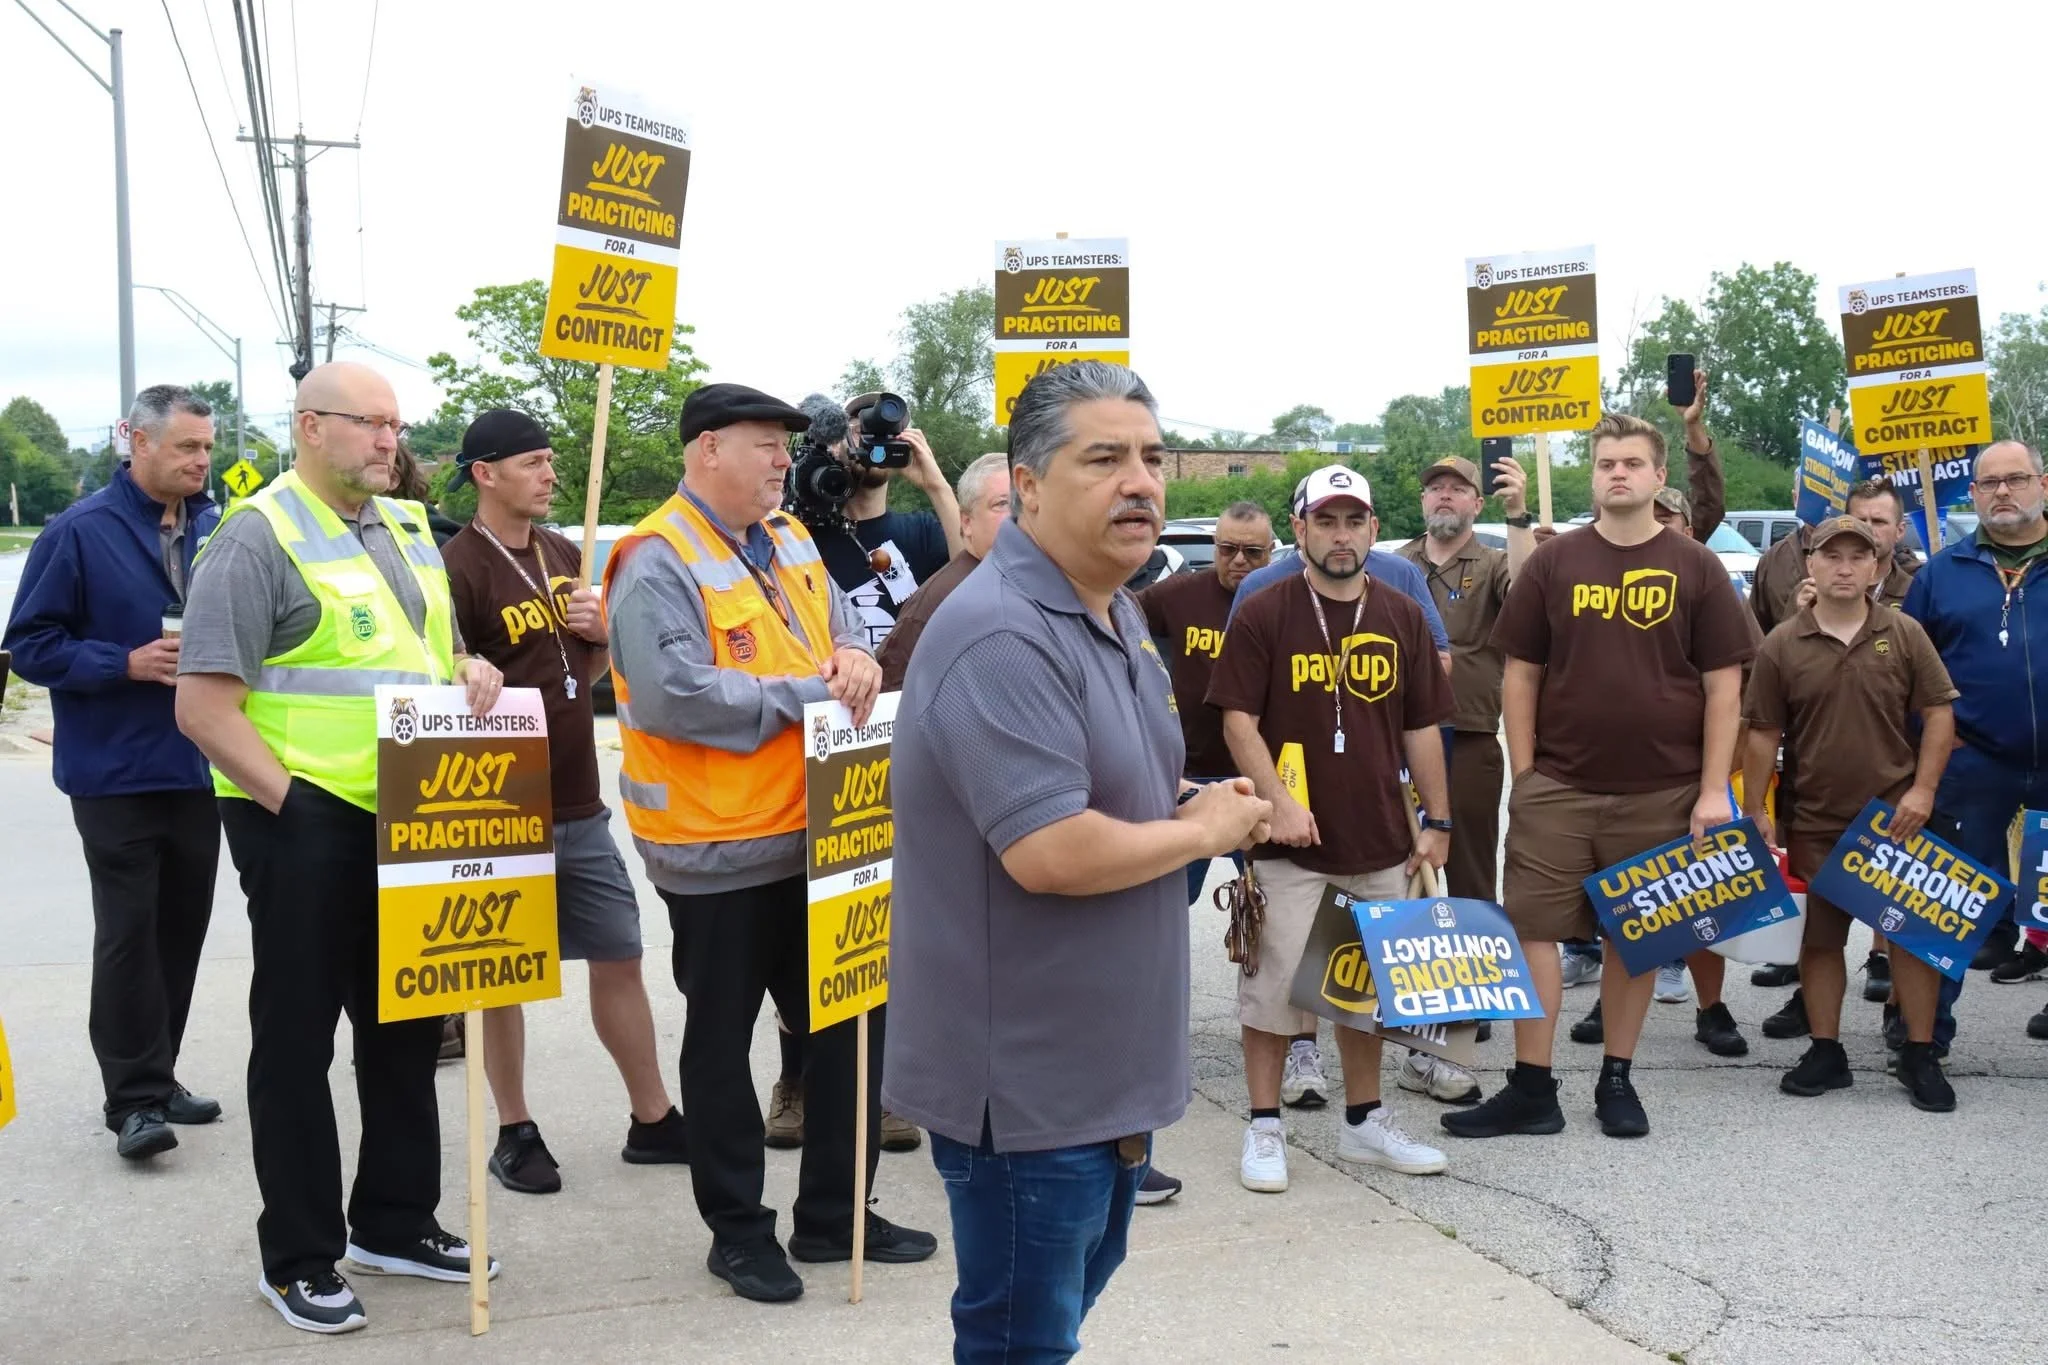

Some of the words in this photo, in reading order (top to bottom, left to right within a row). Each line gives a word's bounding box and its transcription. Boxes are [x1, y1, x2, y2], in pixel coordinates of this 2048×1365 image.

[600, 106, 622, 126] UPS
[624, 113, 686, 145] TEAMSTERS:
[592, 143, 665, 189] JUST
[567, 192, 676, 239] PRACTICING
[604, 238, 626, 254] FOR
[626, 242, 635, 255] A
[1026, 256, 1049, 266] UPS
[1051, 254, 1122, 266] TEAMSTERS:
[579, 263, 653, 305] JUST
[1496, 268, 1518, 281] UPS
[1520, 262, 1589, 278] TEAMSTERS:
[1024, 276, 1101, 304] JUST
[1495, 285, 1569, 317] JUST
[1871, 294, 1895, 306] UPS
[1897, 284, 1969, 302] TEAMSTERS:
[556, 314, 664, 352] CONTRACT
[1003, 315, 1121, 333] PRACTICING
[1477, 321, 1590, 347] PRACTICING
[1872, 307, 1949, 341] JUST
[1046, 341, 1068, 350] FOR
[1069, 341, 1078, 350] A
[1517, 351, 1538, 360] FOR
[1540, 350, 1548, 359] A
[1854, 340, 1975, 371] PRACTICING
[1498, 365, 1571, 395] JUST
[1899, 370, 1921, 381] FOR
[1923, 369, 1932, 379] A
[1481, 401, 1591, 425] CONTRACT
[1881, 383, 1956, 414] JUST
[1864, 416, 1979, 444] CONTRACT
[1806, 428, 1838, 459] GAM
[1835, 448, 1856, 472] ON
[1573, 584, 1621, 620] pay
[1627, 586, 1667, 619] up
[501, 598, 555, 645] pay
[735, 646, 752, 655] 710
[1185, 625, 1226, 658] pay
[1291, 652, 1339, 693] pay
[1350, 654, 1391, 691] up
[422, 715, 453, 731] UPS
[456, 714, 539, 732] TEAMSTERS:
[832, 727, 853, 746] UPS
[854, 720, 895, 743] TEAMSTE
[420, 751, 516, 799] JUST
[833, 758, 891, 812] JUST
[391, 815, 544, 852] PRACTICING
[452, 863, 482, 878] FOR
[484, 862, 493, 877] A
[853, 869, 870, 887] FOR
[871, 867, 879, 881] A
[1599, 829, 1748, 898] UNITED
[1857, 834, 1871, 848] FOR
[1870, 843, 1987, 920] STRONG
[1612, 904, 1628, 917] FOR
[1627, 902, 1634, 912] A
[1632, 844, 1755, 917] STRONG
[1842, 850, 1977, 942] CONTRACT
[422, 890, 522, 942] JUST
[835, 891, 891, 950] JUST
[1622, 869, 1767, 941] CONTRACT
[1693, 916, 1711, 927] UPS
[1382, 934, 1512, 965] CONTRACT
[395, 951, 547, 999] CONTRACT
[819, 955, 889, 1008] CONTRA
[1389, 954, 1504, 995] STRONG
[1506, 968, 1520, 978] FOR
[1394, 986, 1530, 1016] UNITED
